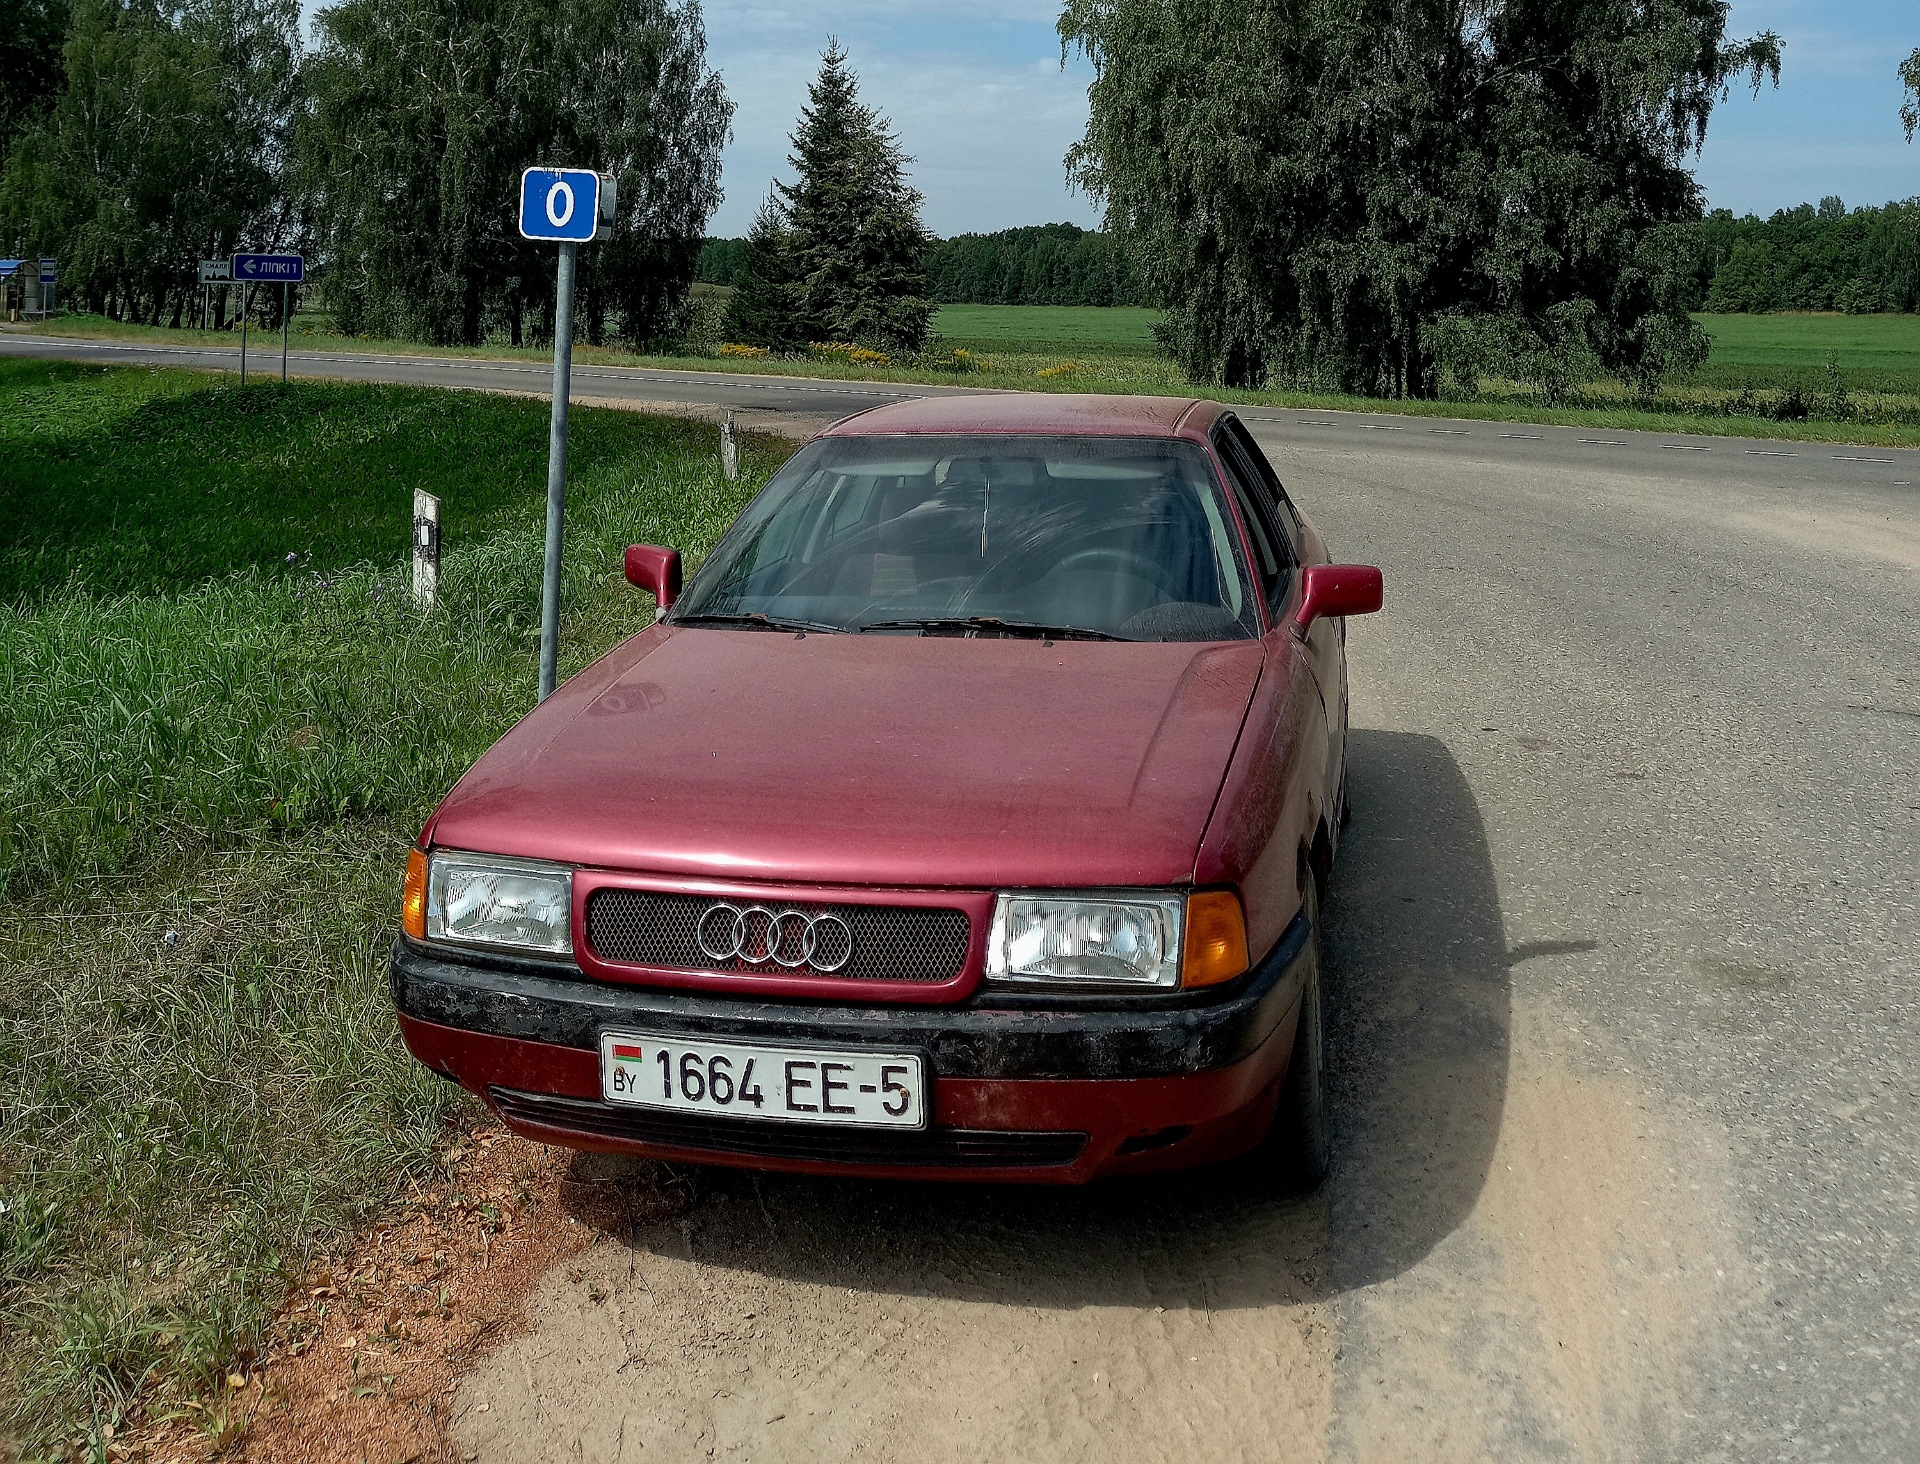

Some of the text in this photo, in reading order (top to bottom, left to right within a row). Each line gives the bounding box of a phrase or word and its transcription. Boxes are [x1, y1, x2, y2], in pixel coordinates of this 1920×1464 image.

[546, 181, 574, 227] 0
[613, 1071, 636, 1094] BY
[656, 1049, 910, 1117] 1664 EE-5
